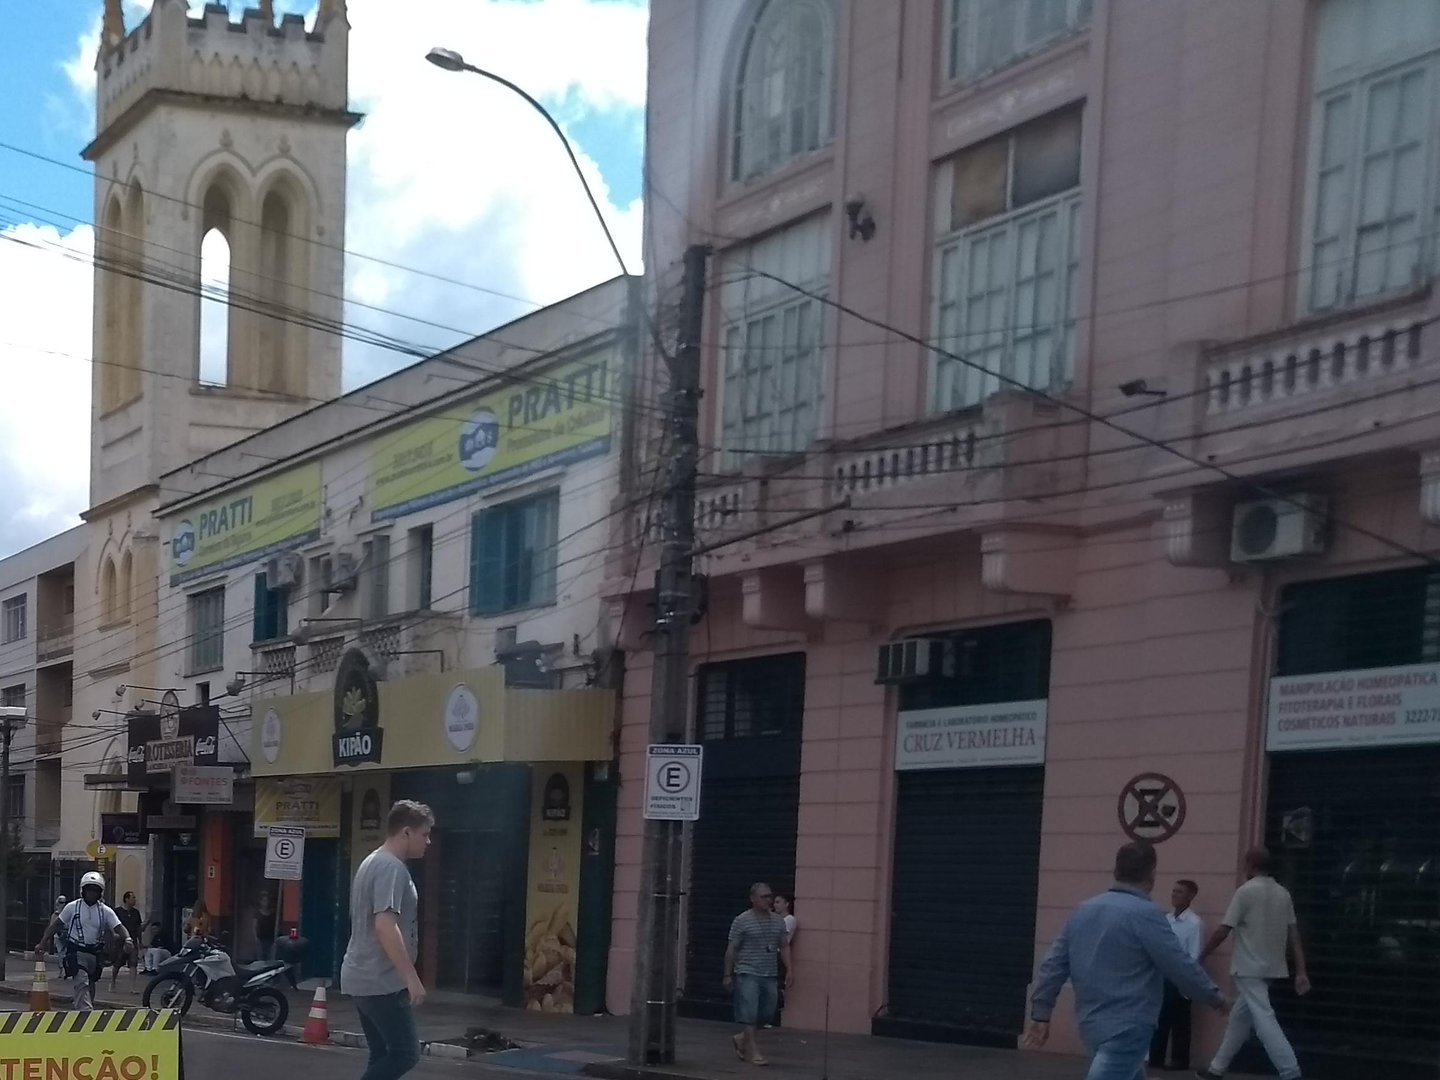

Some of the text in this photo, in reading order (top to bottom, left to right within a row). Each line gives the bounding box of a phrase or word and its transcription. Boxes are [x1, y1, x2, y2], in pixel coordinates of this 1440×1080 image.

[508, 360, 608, 432] PRATTI
[199, 496, 253, 540] PRATTI
[1279, 677, 1354, 696] MANIPULAÇÃO
[1278, 699, 1344, 714] FITOTERAPIA
[1356, 693, 1402, 708] FLORAIS
[1343, 711, 1397, 726] NATURAIS
[339, 732, 371, 758] KIPÃO
[903, 727, 1036, 753] CRUZ VERMELHA
[666, 767, 681, 787] E
[276, 801, 319, 810] PRATTI
[280, 842, 289, 855] E
